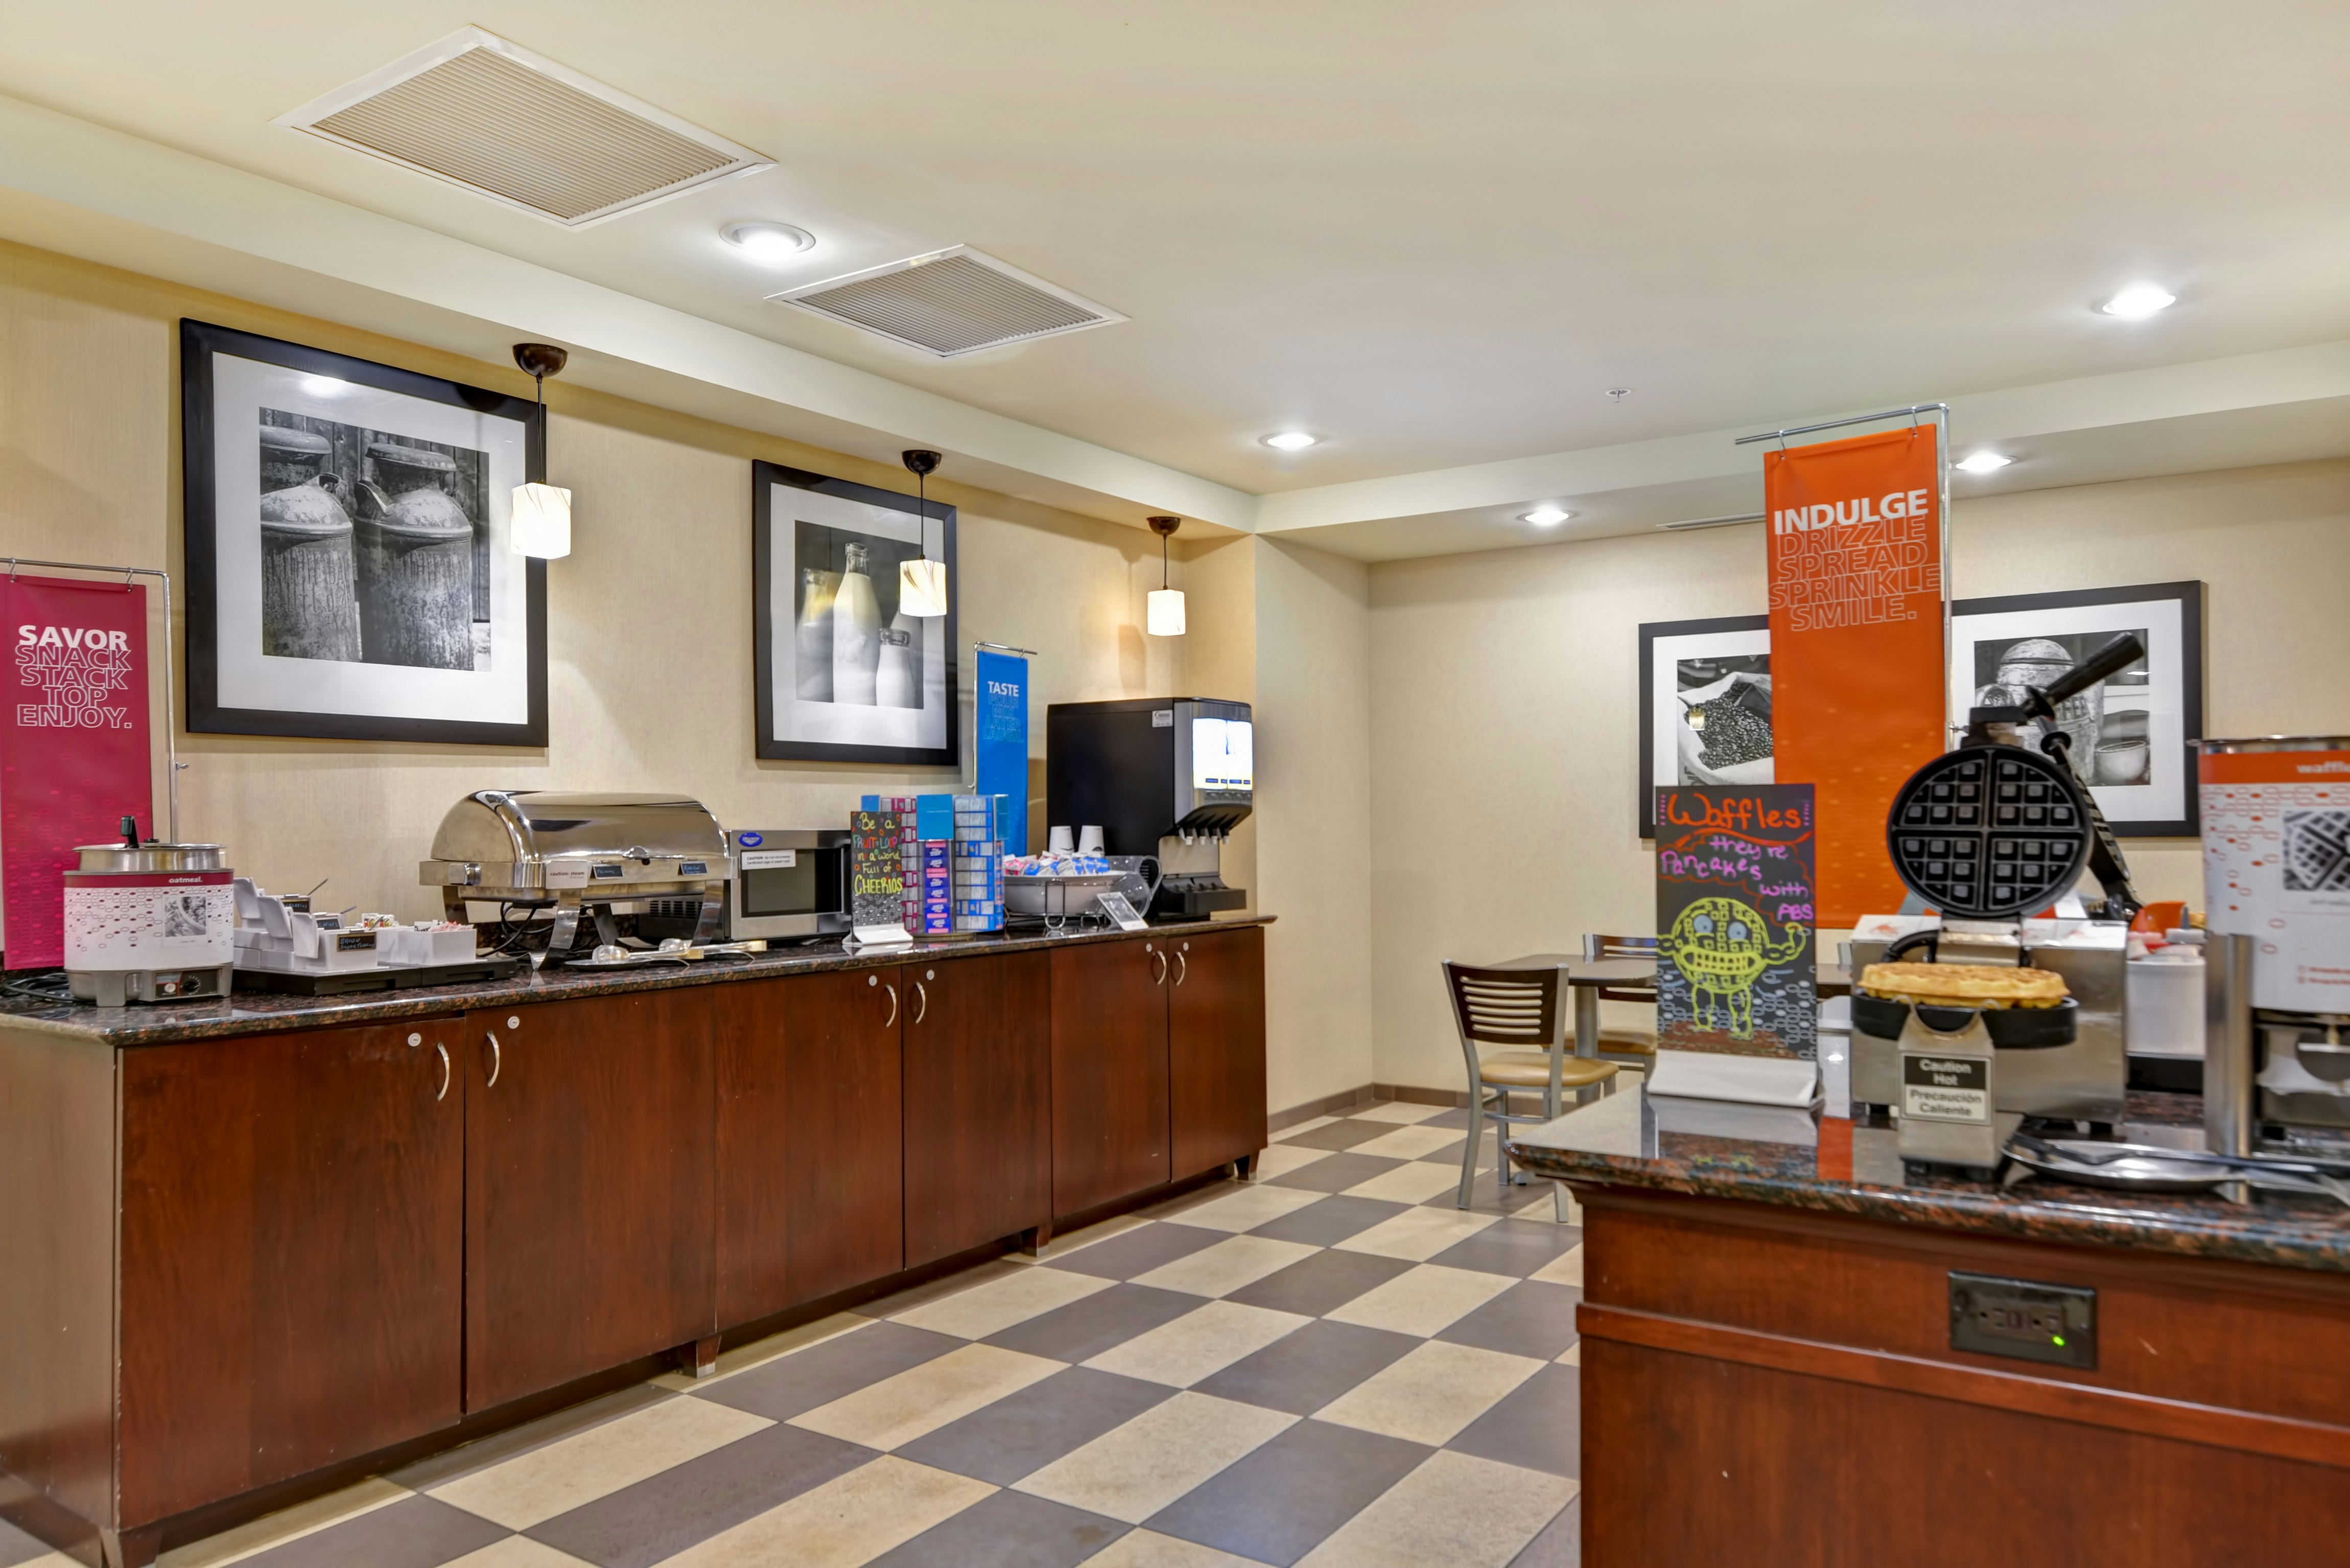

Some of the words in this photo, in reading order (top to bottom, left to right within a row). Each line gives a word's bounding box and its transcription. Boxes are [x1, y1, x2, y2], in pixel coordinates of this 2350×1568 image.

[1774, 489, 1929, 535] INDULGE
[1778, 513, 1927, 559] DRIZZLE
[1777, 540, 1929, 584] SPREAD
[1768, 563, 1941, 610] SPRINKLE
[1790, 594, 1917, 631] SMILE.
[18, 625, 128, 651] SAVOR
[15, 644, 132, 670] SNACK
[20, 664, 128, 690] STACK
[42, 685, 108, 708] TOP
[988, 681, 1019, 697] TASTE
[988, 692, 1019, 709] POUR
[17, 704, 132, 729] ENJOY.
[986, 715, 1021, 732] LAYER
[859, 812, 876, 830] Be
[885, 820, 895, 829] a
[1667, 793, 1802, 830] Waffles
[857, 852, 864, 861] in
[870, 853, 876, 861] a
[878, 851, 901, 860] world
[862, 862, 879, 874] Full
[883, 861, 891, 873] of
[1660, 850, 1761, 880] Pancakes
[854, 874, 903, 895] CHEERIOS
[1759, 880, 1808, 898] with
[1919, 1059, 1972, 1074] Caution
[1933, 1072, 1959, 1086] Hot
[1919, 1102, 1972, 1116] Caliente
